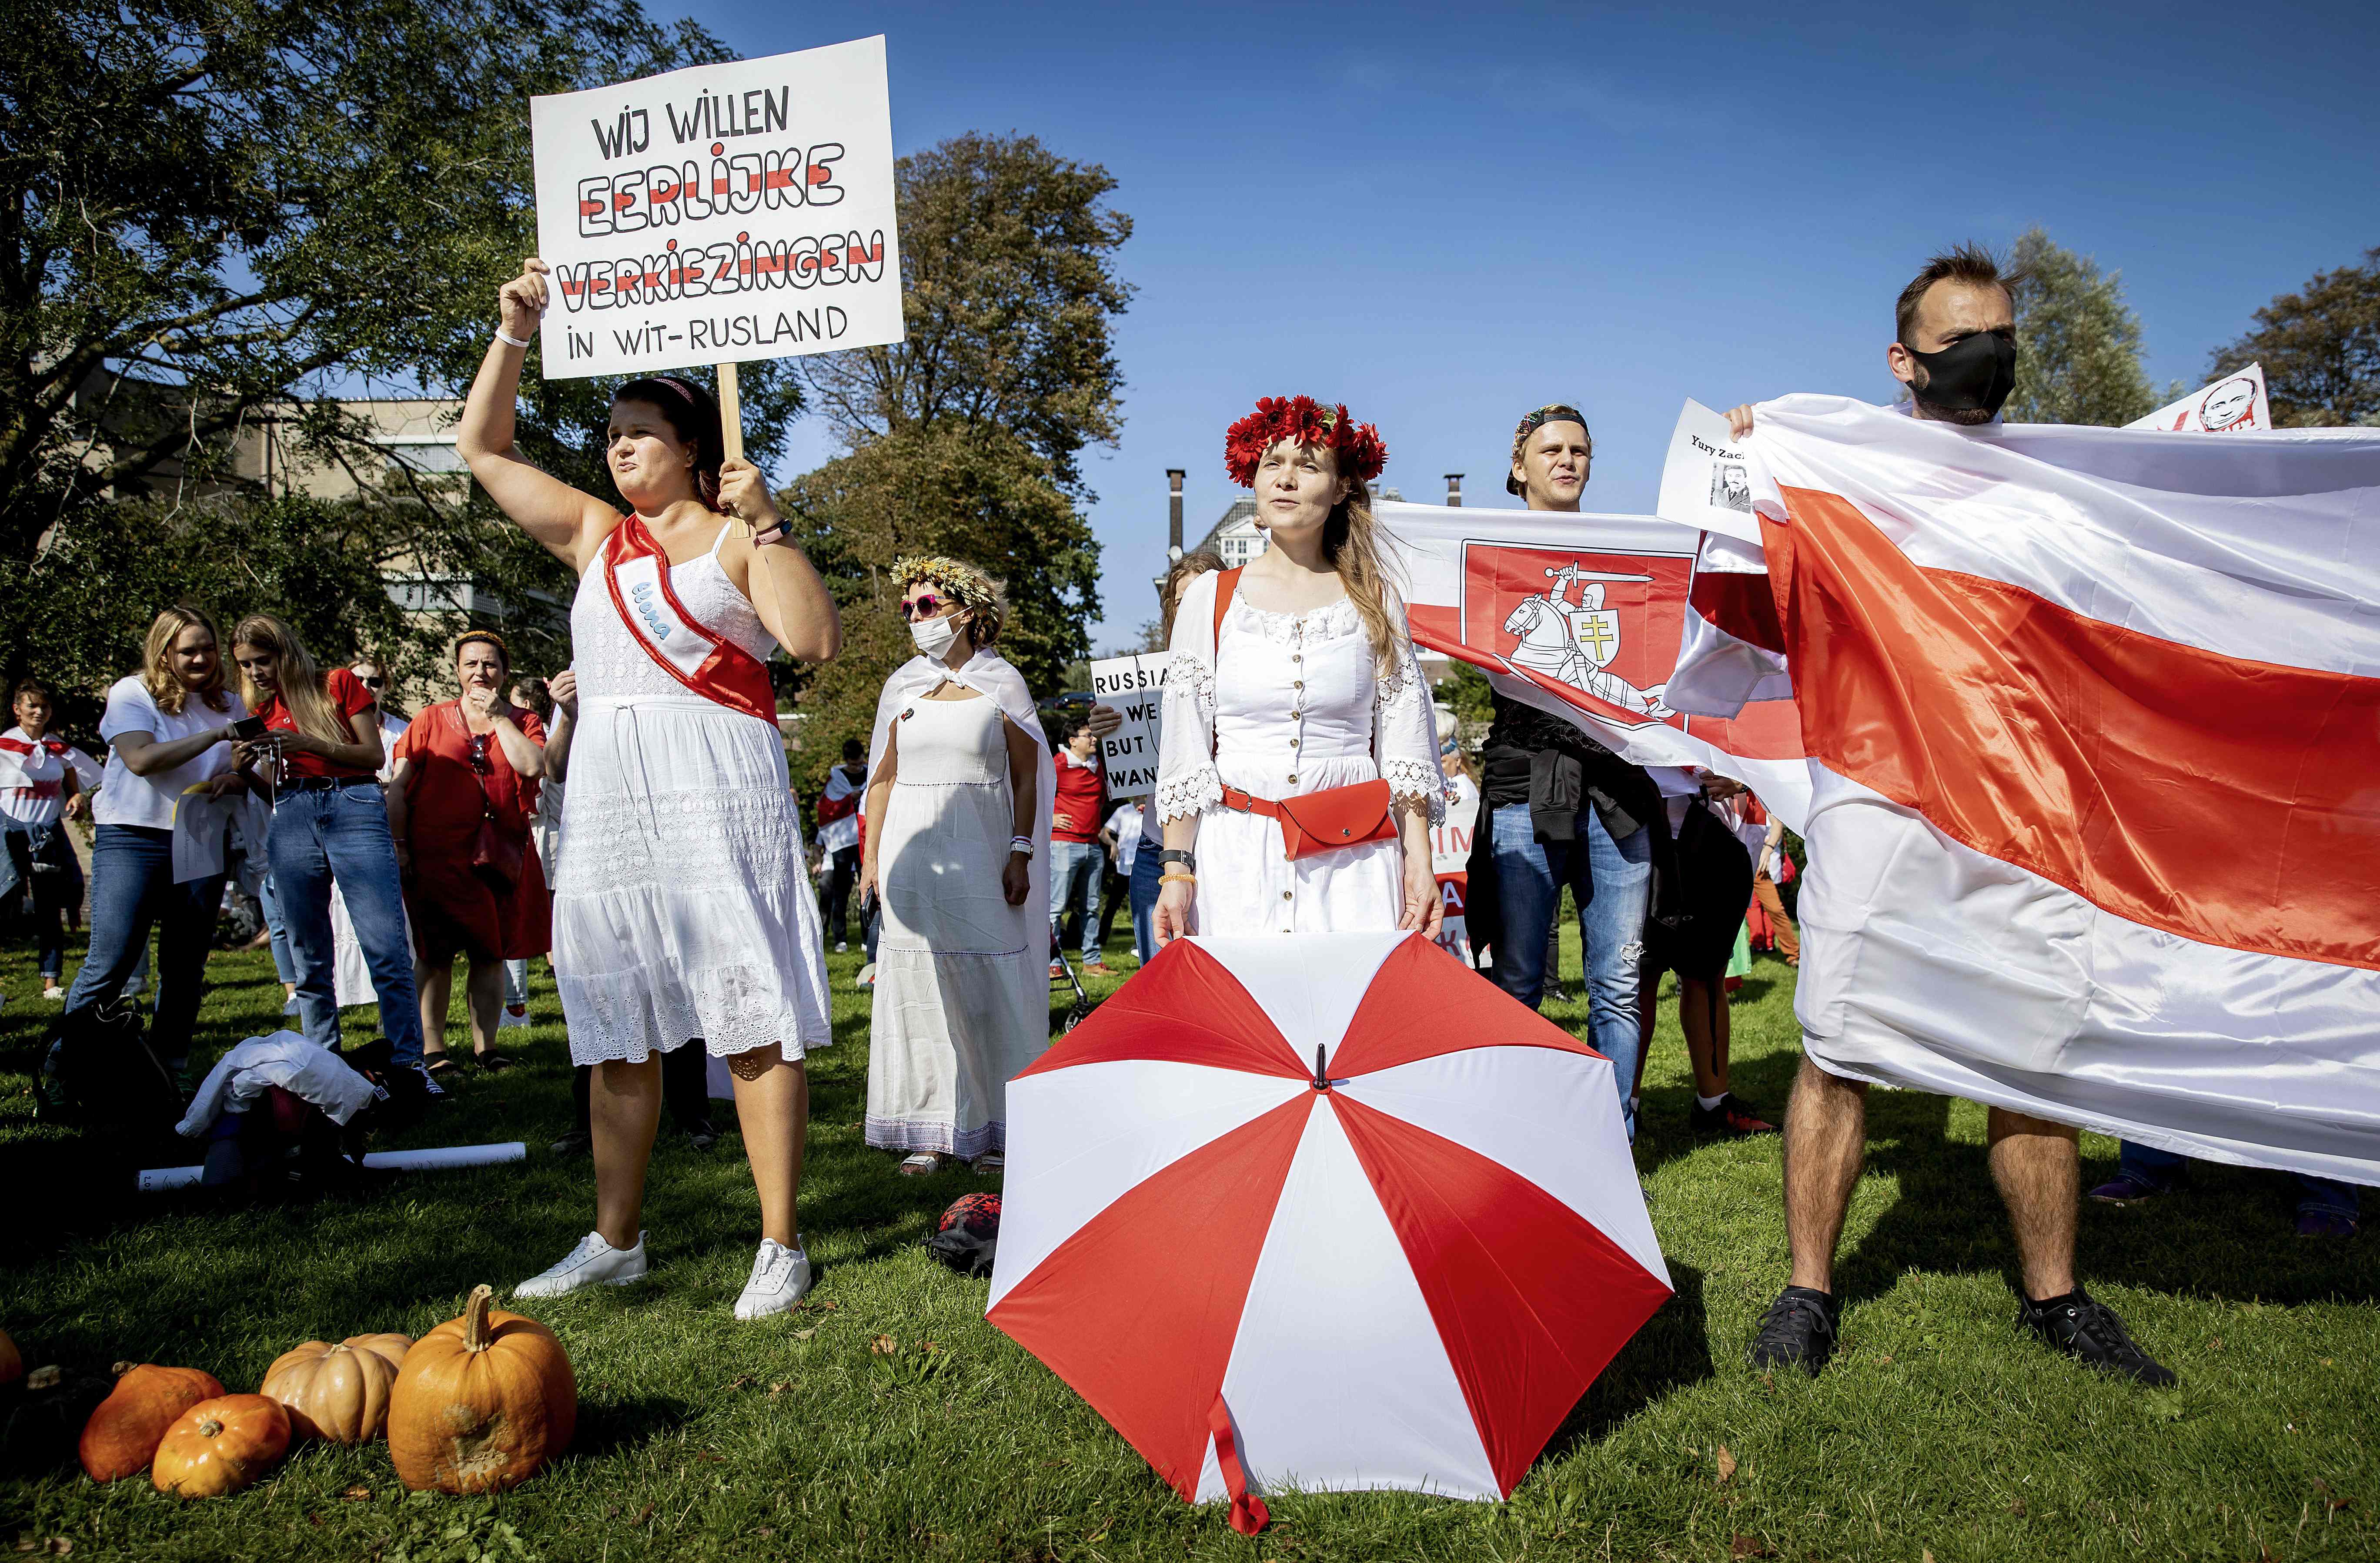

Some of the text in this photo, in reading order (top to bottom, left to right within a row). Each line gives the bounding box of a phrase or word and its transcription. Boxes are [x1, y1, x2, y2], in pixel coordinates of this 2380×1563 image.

[1691, 435, 1745, 459] Yury Zac
[1126, 703, 1157, 723] WE
[1106, 736, 1144, 758] BUT
[1109, 765, 1159, 788] WAN
